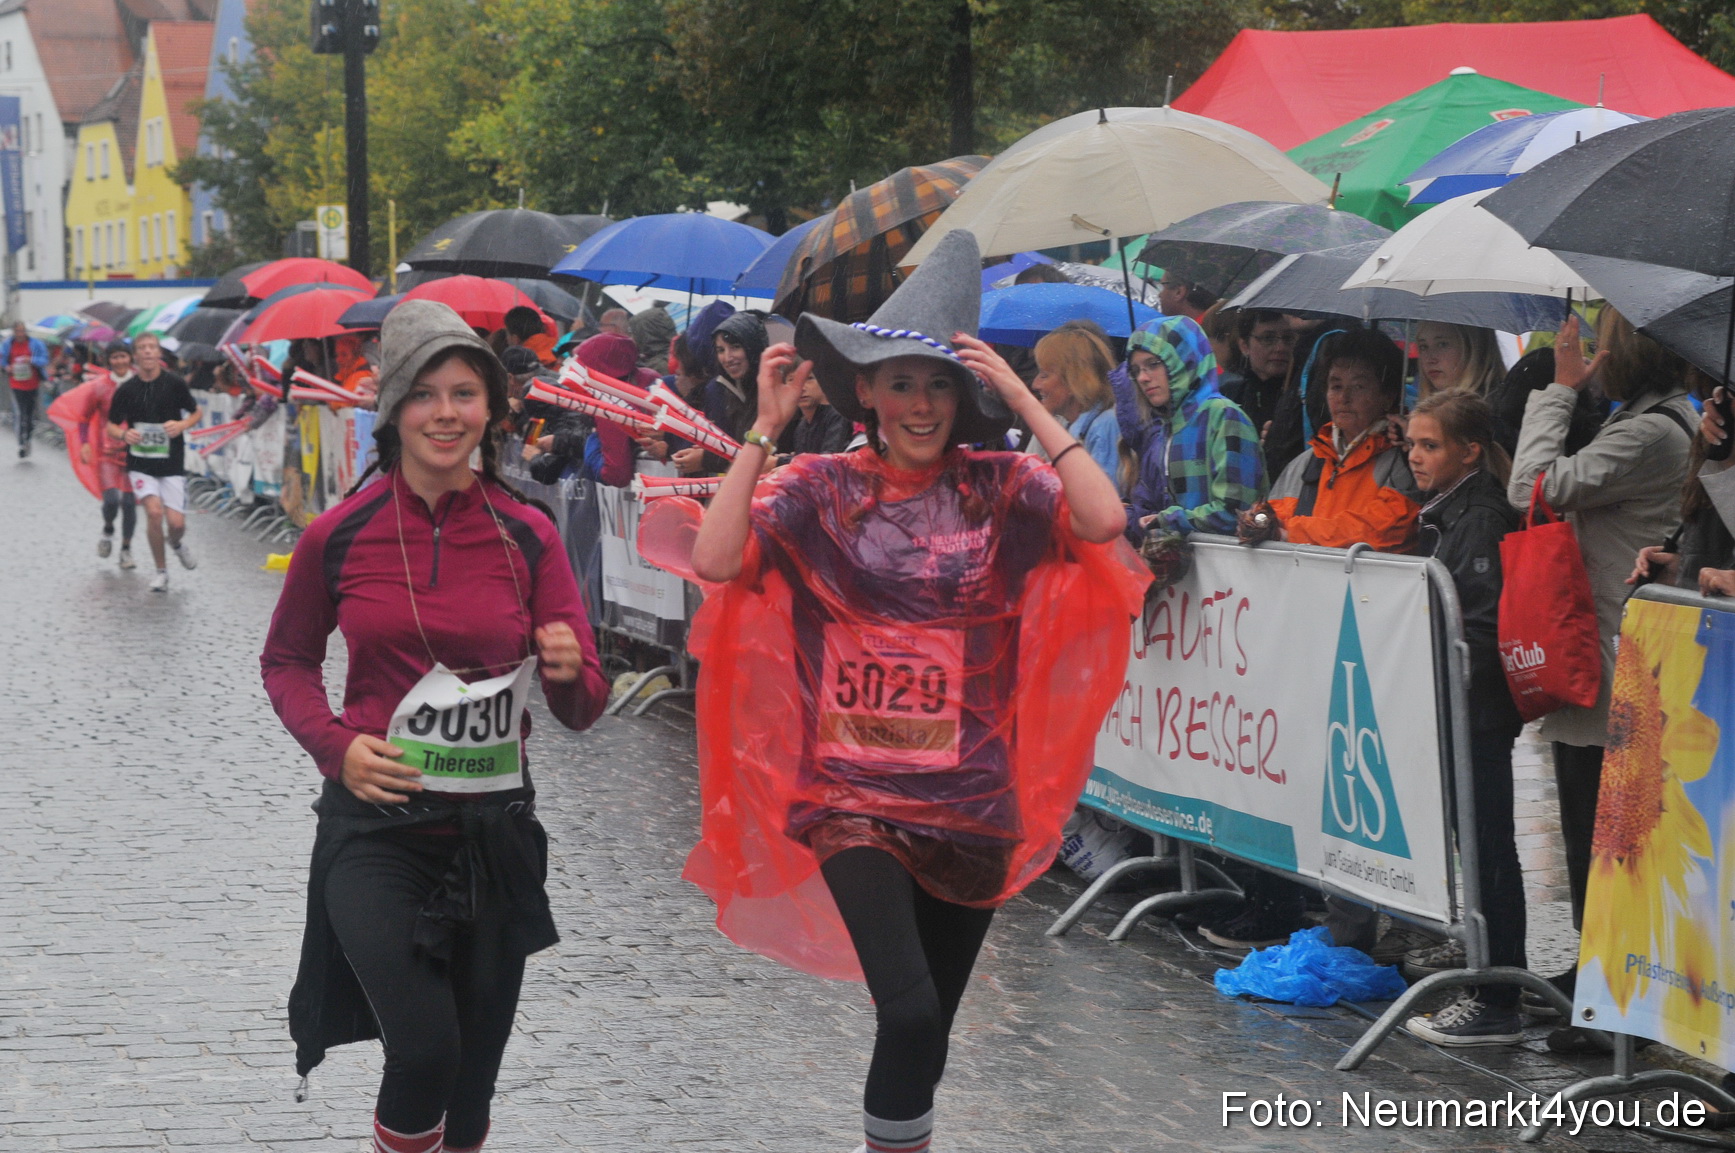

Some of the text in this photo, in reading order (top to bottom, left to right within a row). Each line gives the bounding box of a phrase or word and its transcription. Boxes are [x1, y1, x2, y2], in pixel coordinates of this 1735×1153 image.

[836, 661, 948, 714] 5029
[1156, 686, 1287, 785] BESSER.
[423, 749, 495, 774] Theresa
[1389, 868, 1417, 894] GmbH
